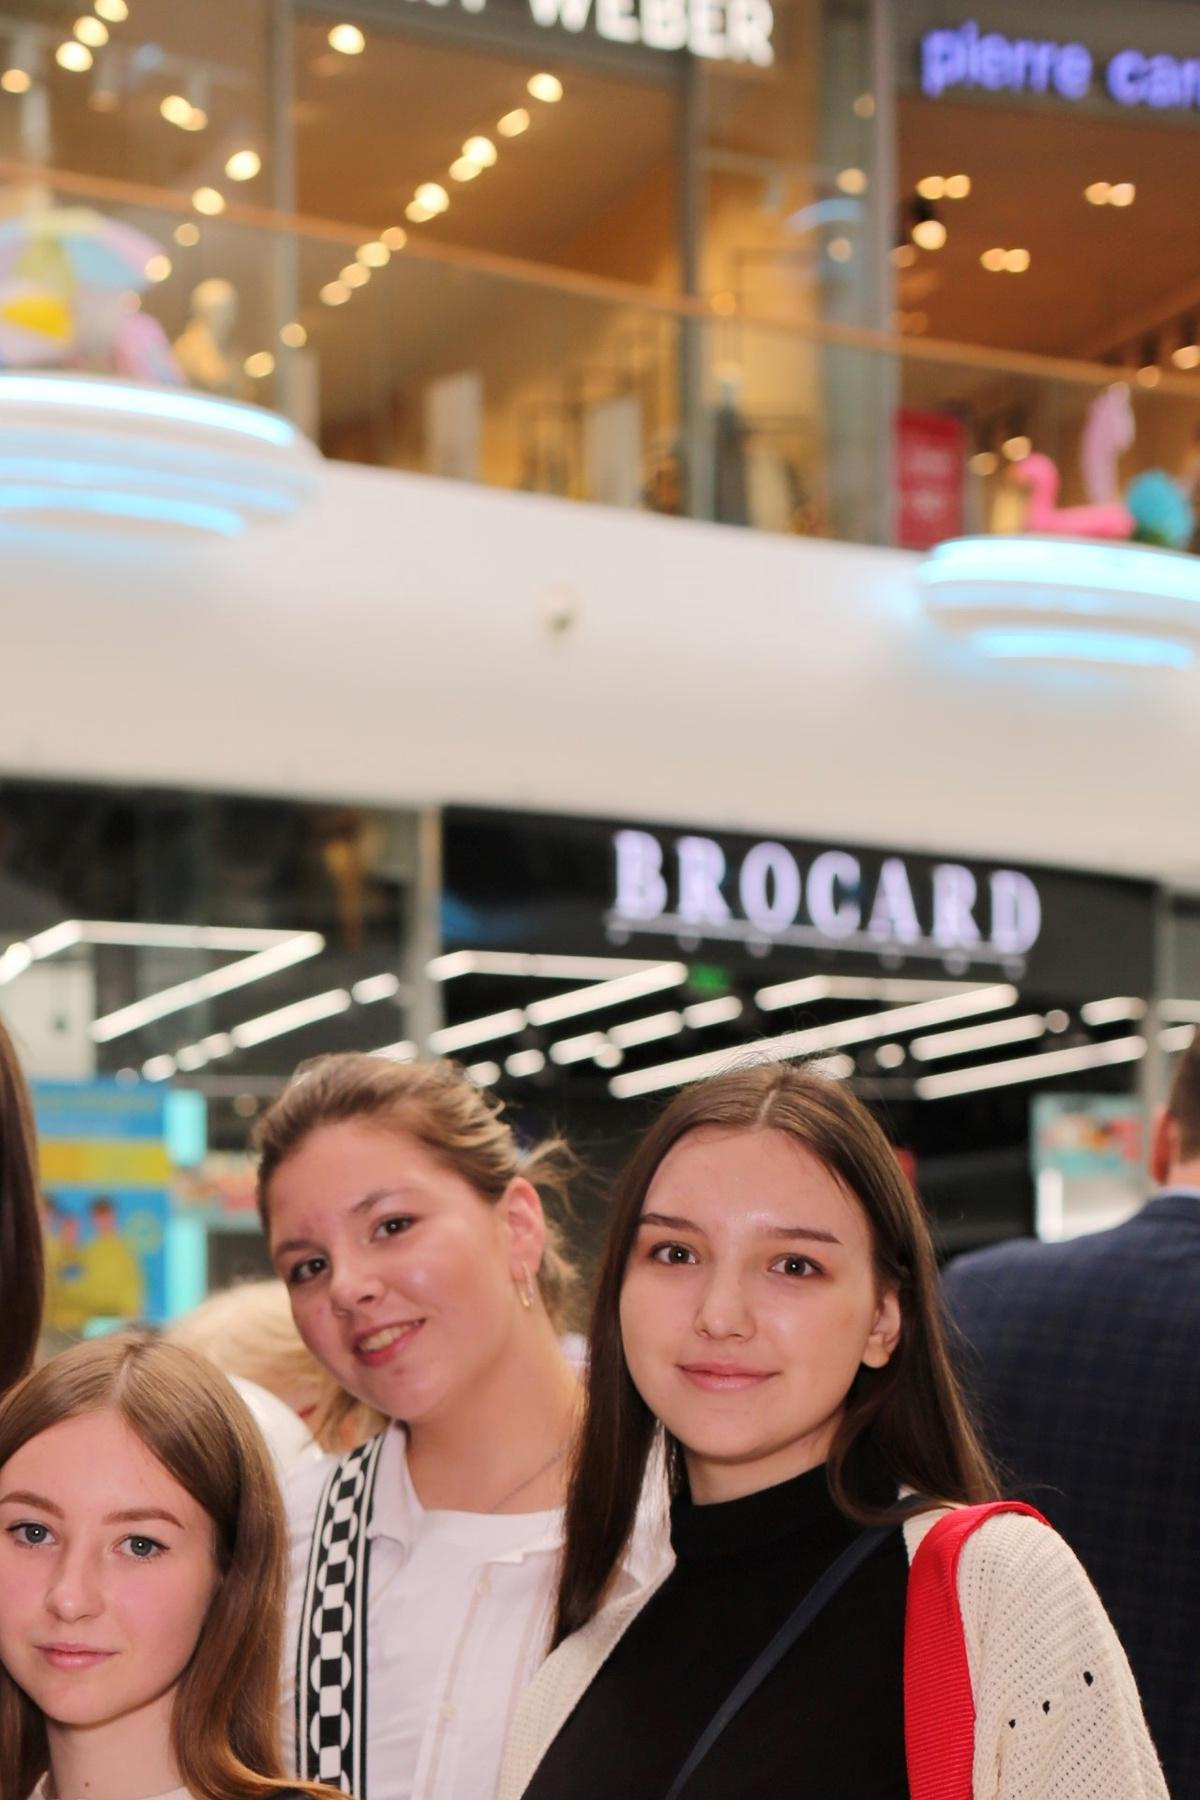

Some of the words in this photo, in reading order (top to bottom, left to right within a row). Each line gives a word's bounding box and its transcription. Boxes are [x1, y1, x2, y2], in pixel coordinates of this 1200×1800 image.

[921, 19, 1092, 99] pierre
[1106, 49, 1200, 109] car
[614, 829, 1042, 955] BROCARD
